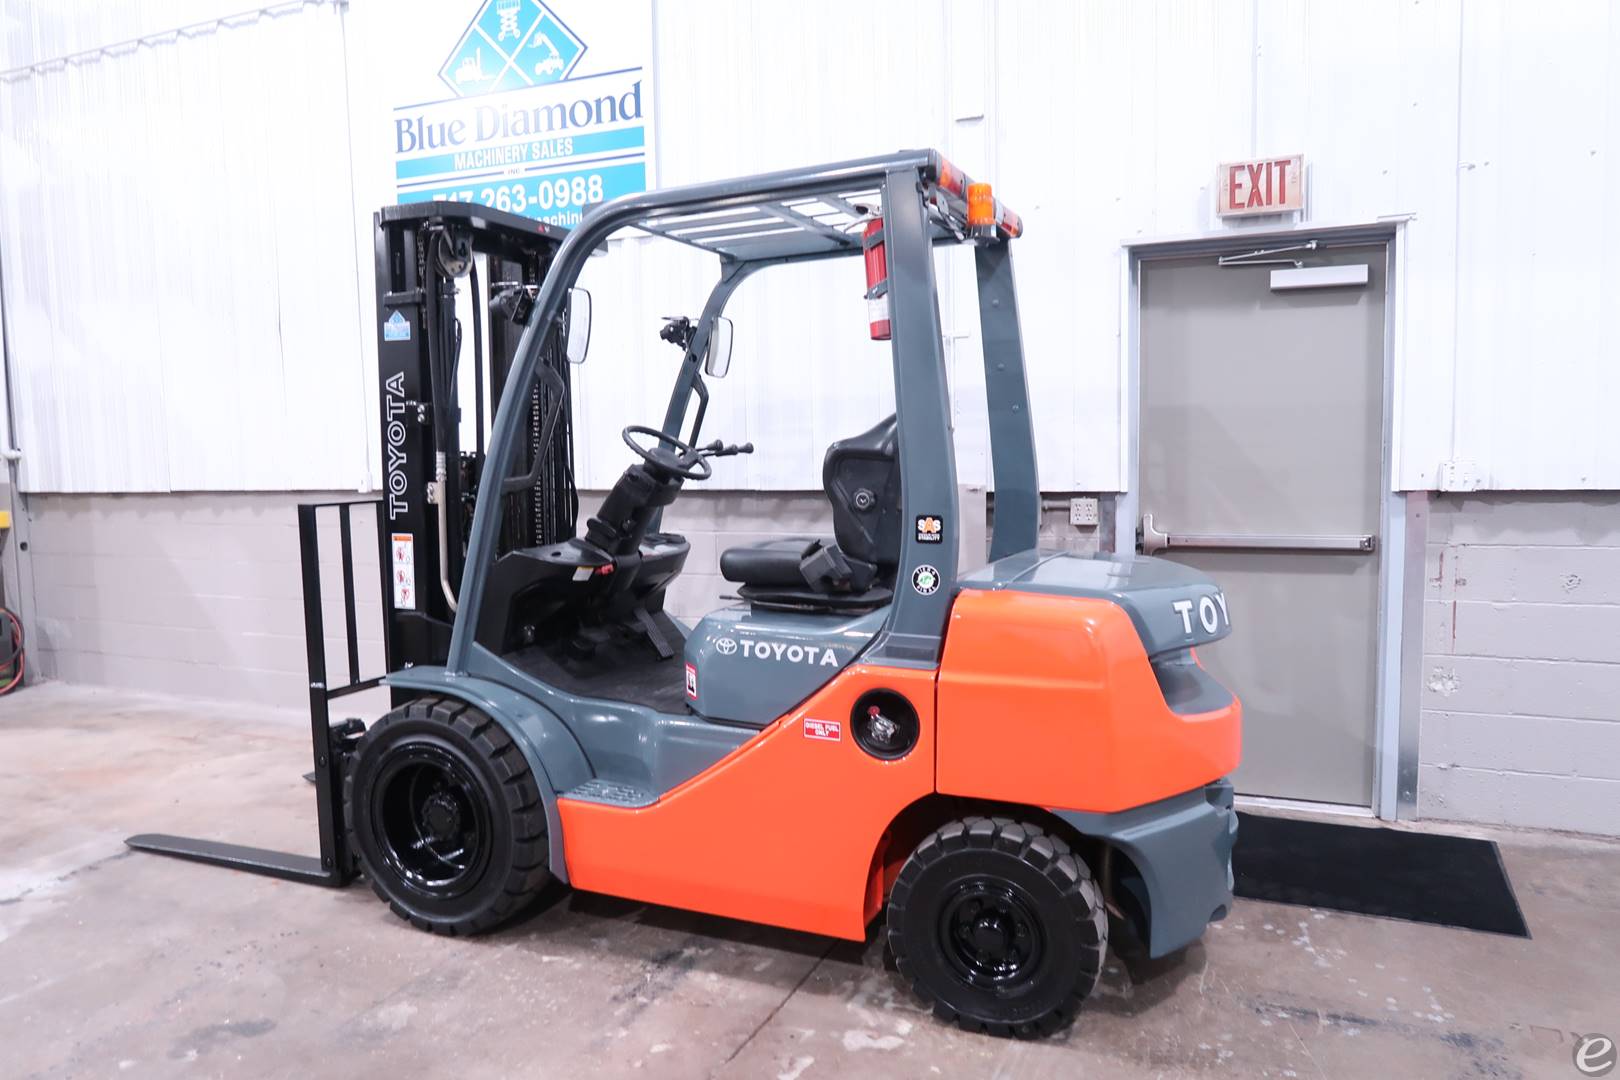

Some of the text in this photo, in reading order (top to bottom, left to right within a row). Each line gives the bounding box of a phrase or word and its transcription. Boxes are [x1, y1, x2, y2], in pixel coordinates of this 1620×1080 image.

[395, 80, 643, 153] Blue Diamond
[454, 137, 573, 171] MACHINERY SALES
[1229, 160, 1291, 209] EXIT
[386, 371, 409, 520] TOYOTA
[918, 517, 941, 534] SAS
[740, 639, 839, 667] TOYOTA
[815, 729, 829, 737] ONLY
[825, 723, 839, 732] FUEL
